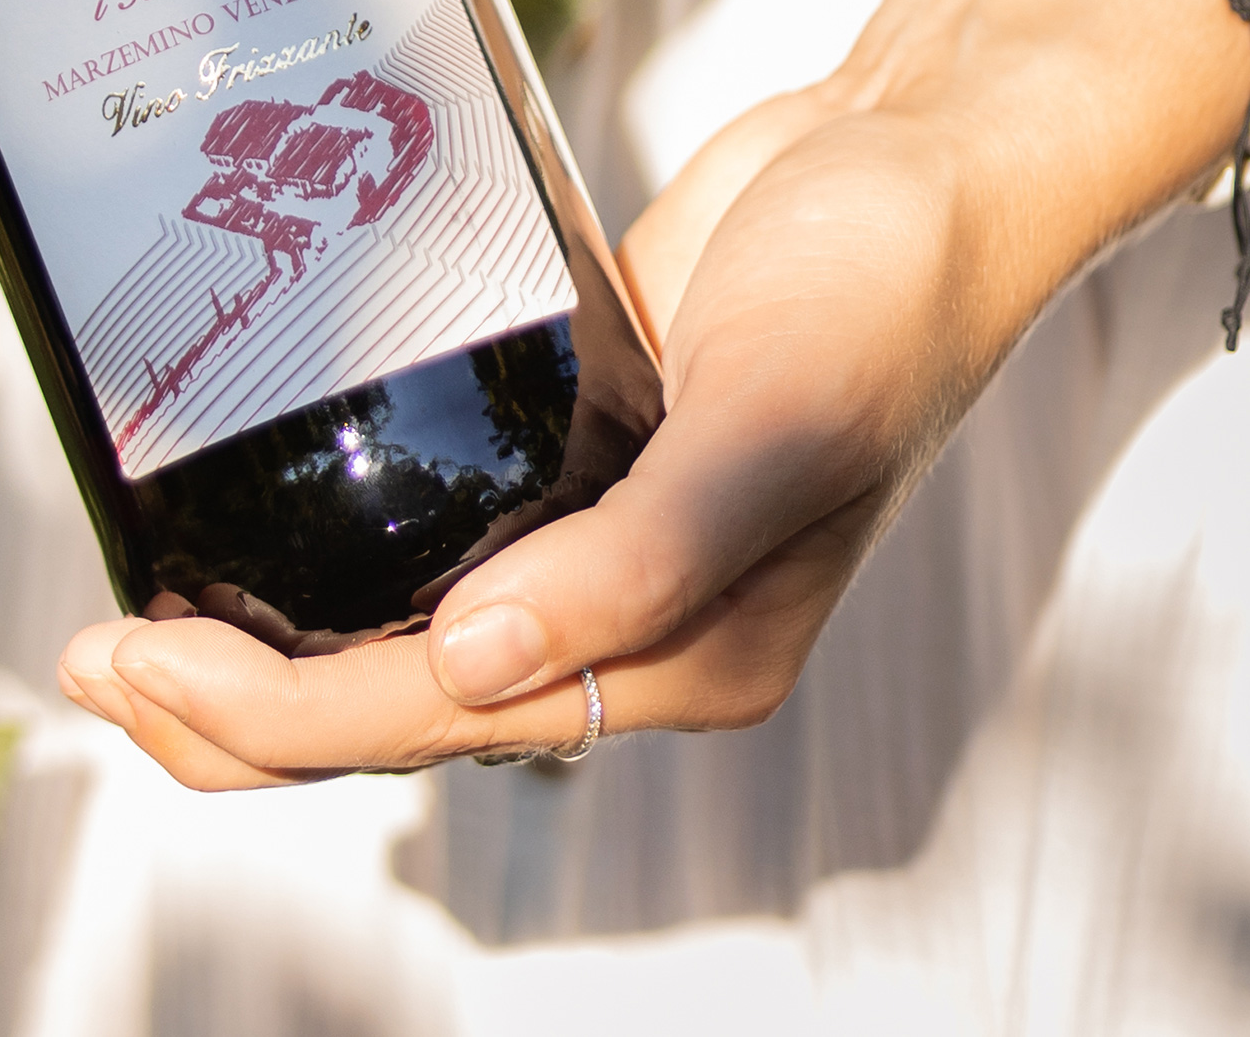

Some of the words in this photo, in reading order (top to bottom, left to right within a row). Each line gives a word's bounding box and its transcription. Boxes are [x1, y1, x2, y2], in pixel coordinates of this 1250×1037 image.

[41, 12, 215, 102] MARZEMINO
[101, 80, 189, 137] Vino
[195, 12, 372, 101] Frizzante
